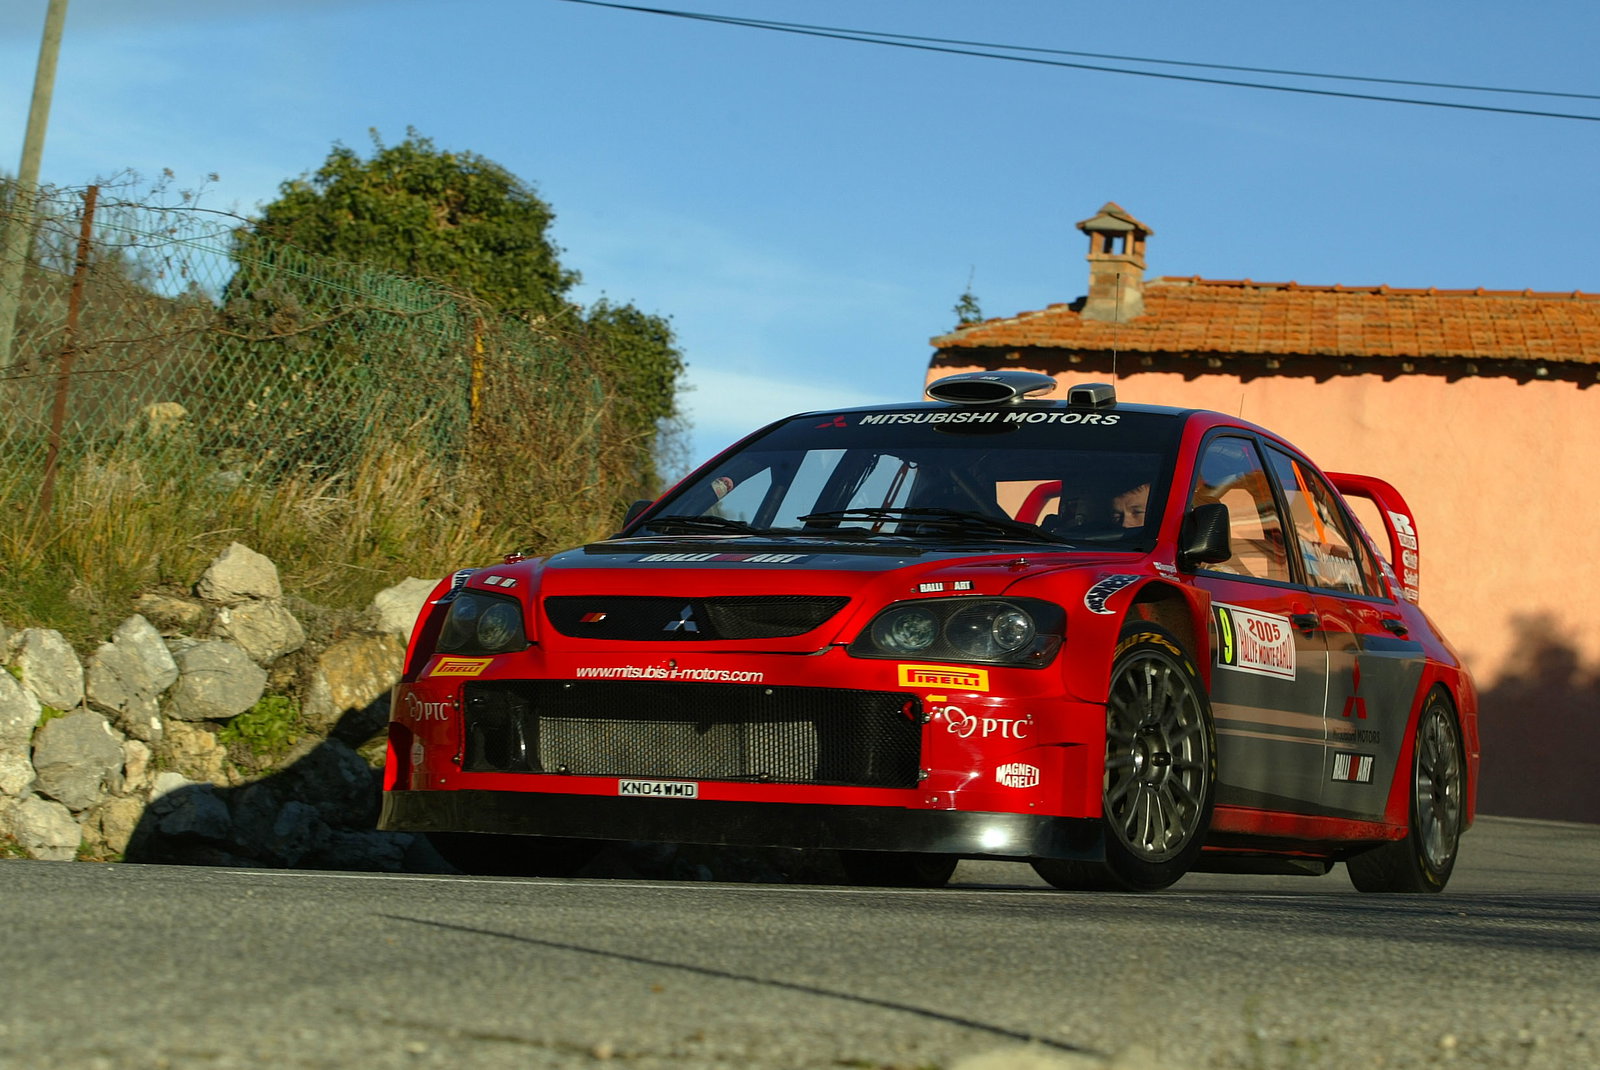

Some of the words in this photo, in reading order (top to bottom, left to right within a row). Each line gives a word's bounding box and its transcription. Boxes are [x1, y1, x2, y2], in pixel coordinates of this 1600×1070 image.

[859, 412, 999, 425] MITSUBISHI
[1003, 412, 1121, 426] MOTORS
[638, 553, 722, 563] RALLI
[742, 554, 809, 564] ART
[919, 582, 944, 593] RALLI
[954, 580, 971, 591] ART
[1219, 607, 1233, 664] 9
[1247, 618, 1281, 643] 2005
[437, 661, 487, 673] PIRELLI
[907, 669, 980, 687] PIRELLI
[424, 702, 449, 721] PTC
[982, 718, 1028, 739] PTC
[996, 762, 1040, 776] MAGNETI
[1332, 753, 1352, 780] RALLI
[1356, 755, 1373, 782] ART
[996, 775, 1040, 788] MARELLI
[621, 782, 694, 797] KN04WMD
